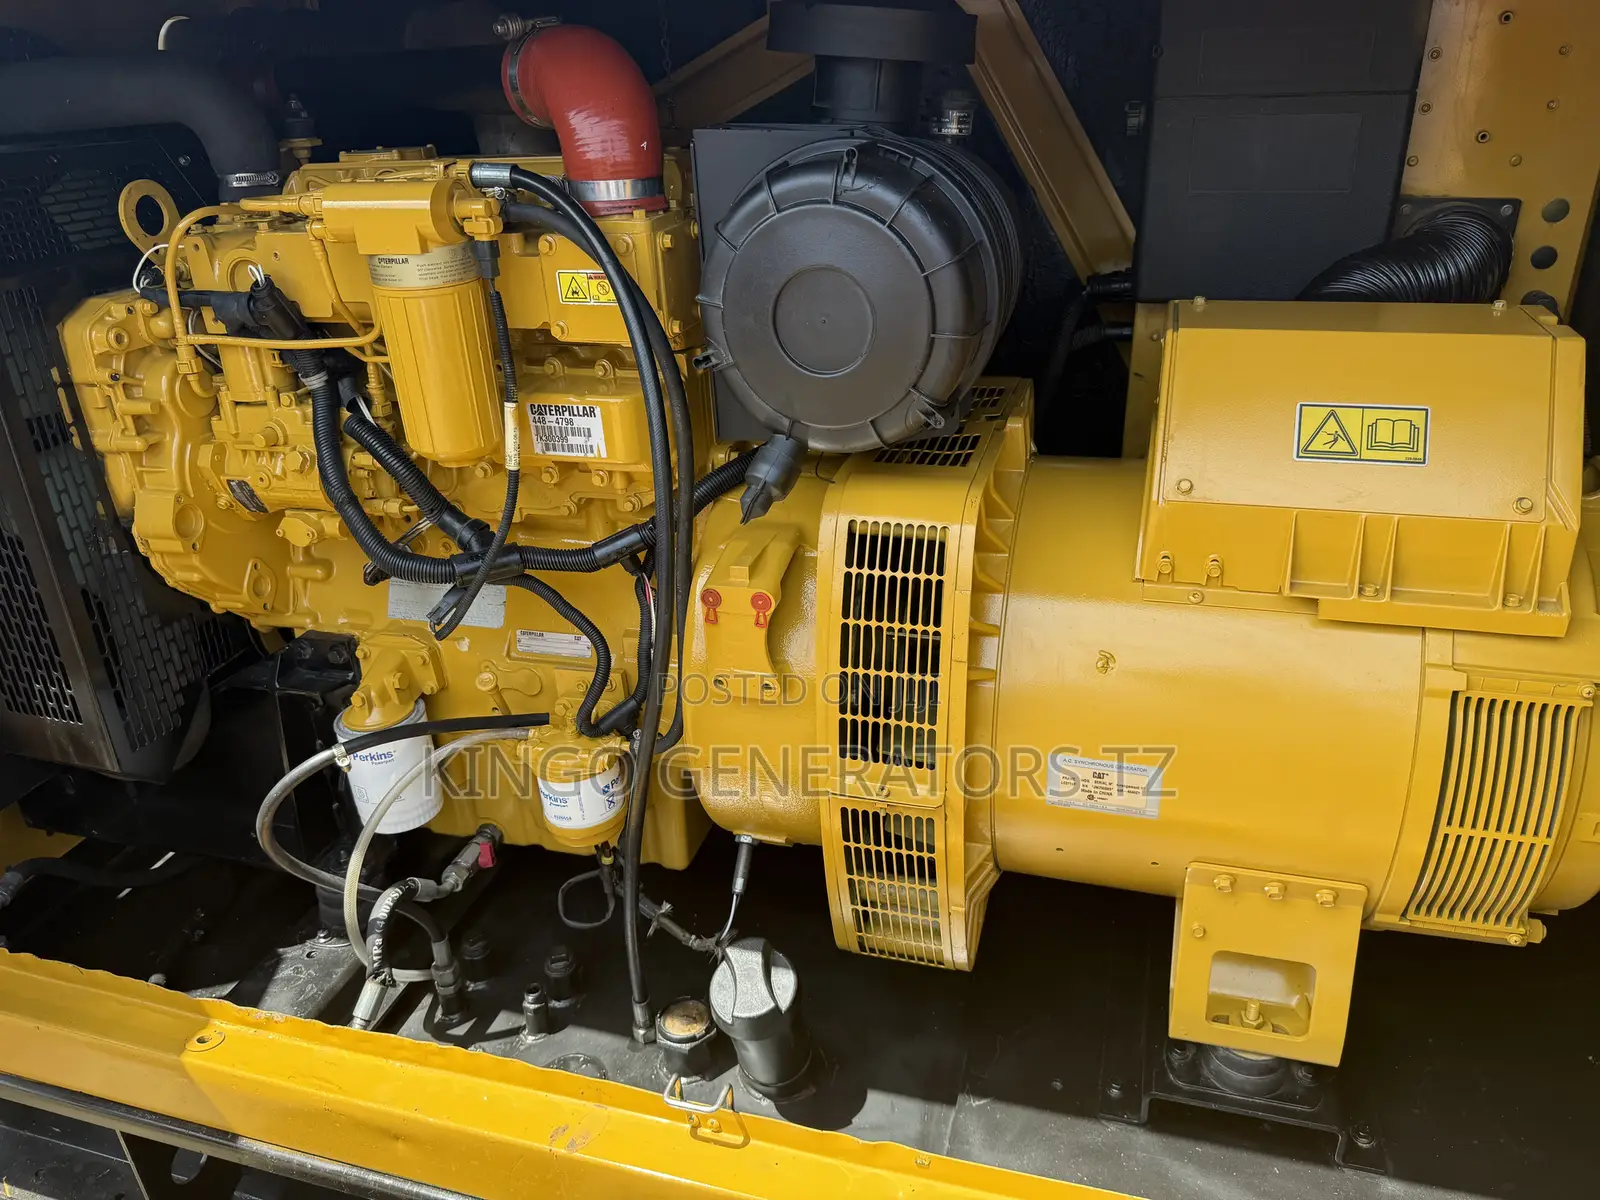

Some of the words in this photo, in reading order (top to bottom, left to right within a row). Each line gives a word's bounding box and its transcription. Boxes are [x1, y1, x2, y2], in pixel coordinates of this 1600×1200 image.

[529, 403, 597, 418] CATERPILLAR
[353, 750, 394, 762] Perkins
[1074, 759, 1114, 769] SYNCHRONOUS
[1092, 771, 1106, 779] CAT
